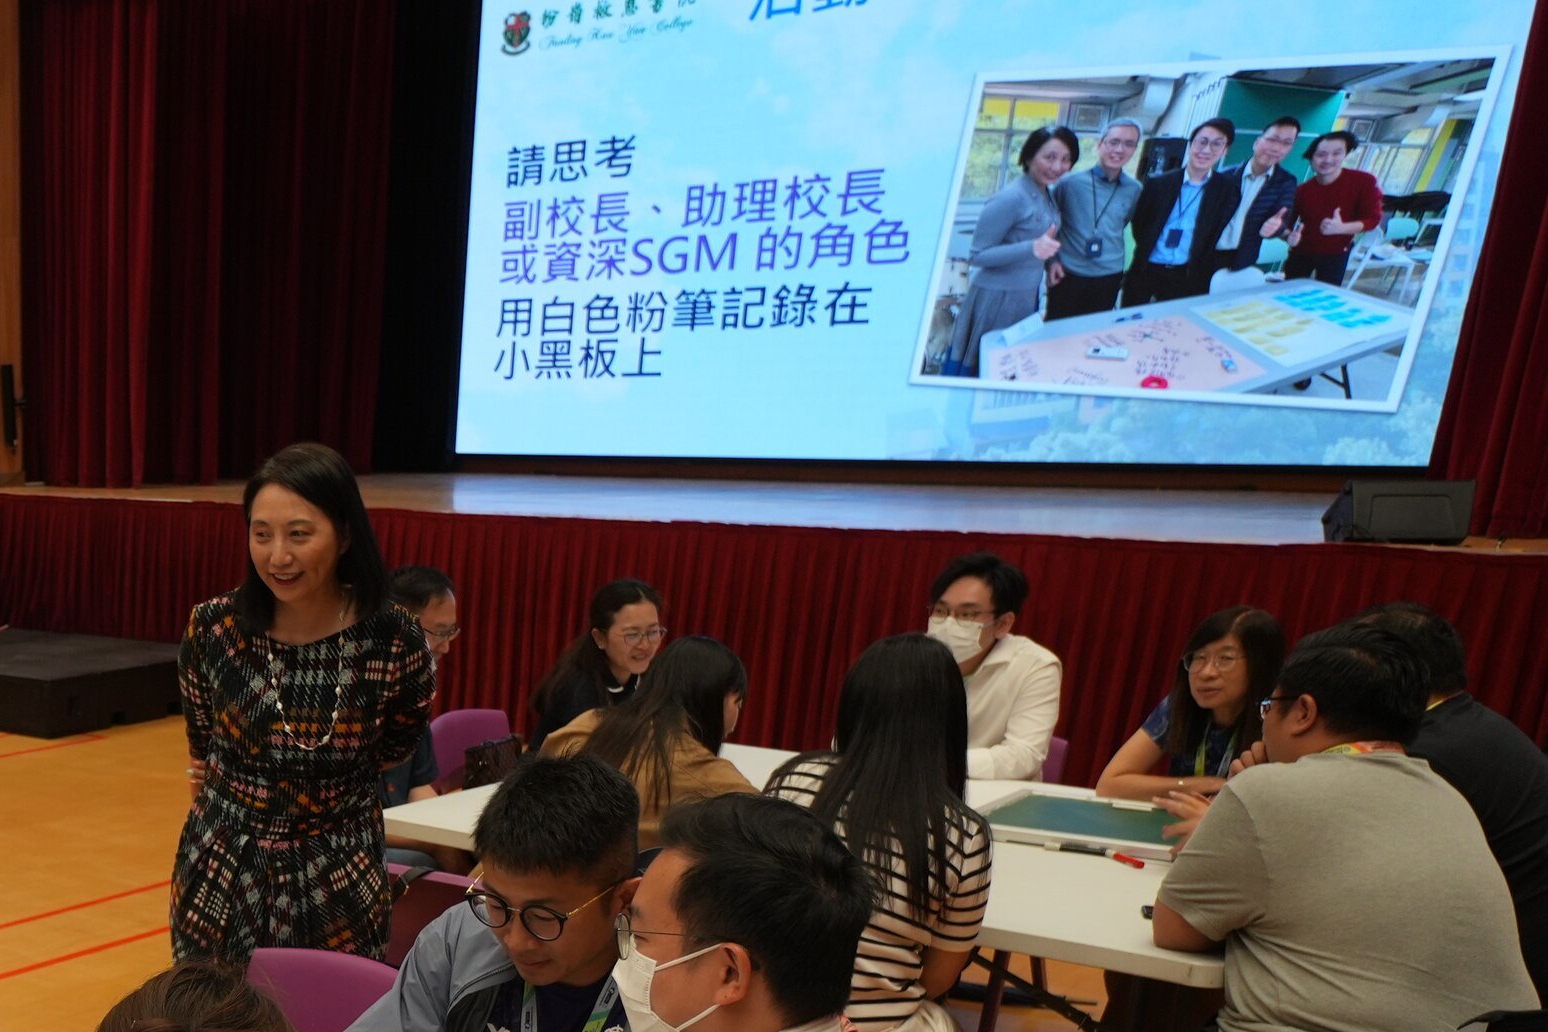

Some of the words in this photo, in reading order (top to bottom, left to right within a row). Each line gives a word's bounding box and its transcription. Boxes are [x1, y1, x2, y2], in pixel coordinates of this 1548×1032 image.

[506, 134, 637, 189] 請思考
[503, 168, 886, 242] 副校長、助理校長
[499, 231, 737, 285] 或資深SGM
[755, 219, 911, 273] 的角色
[496, 281, 873, 339] 用白色粉筆記錄在
[493, 336, 662, 381] 小黑板上
